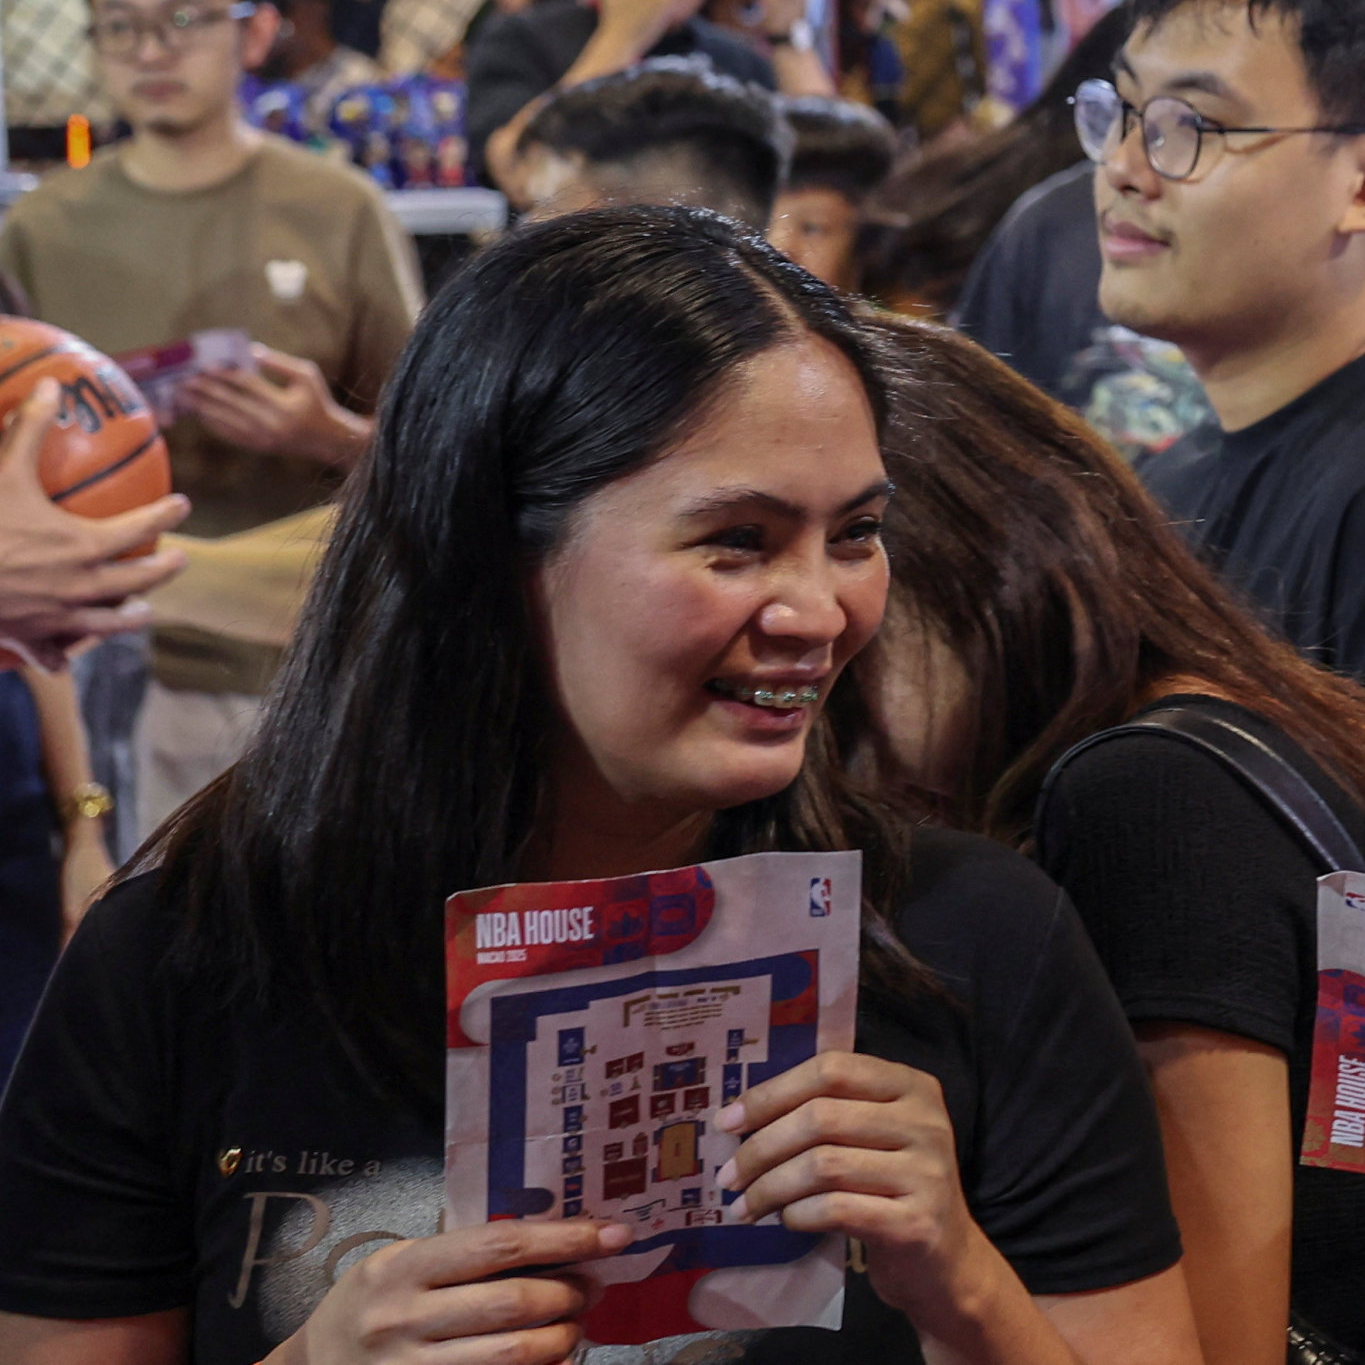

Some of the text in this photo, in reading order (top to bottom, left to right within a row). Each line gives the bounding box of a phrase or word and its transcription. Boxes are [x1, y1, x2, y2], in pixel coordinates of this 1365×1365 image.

[476, 906, 595, 949] NBA HOUSE
[245, 1150, 382, 1177] it's like a
